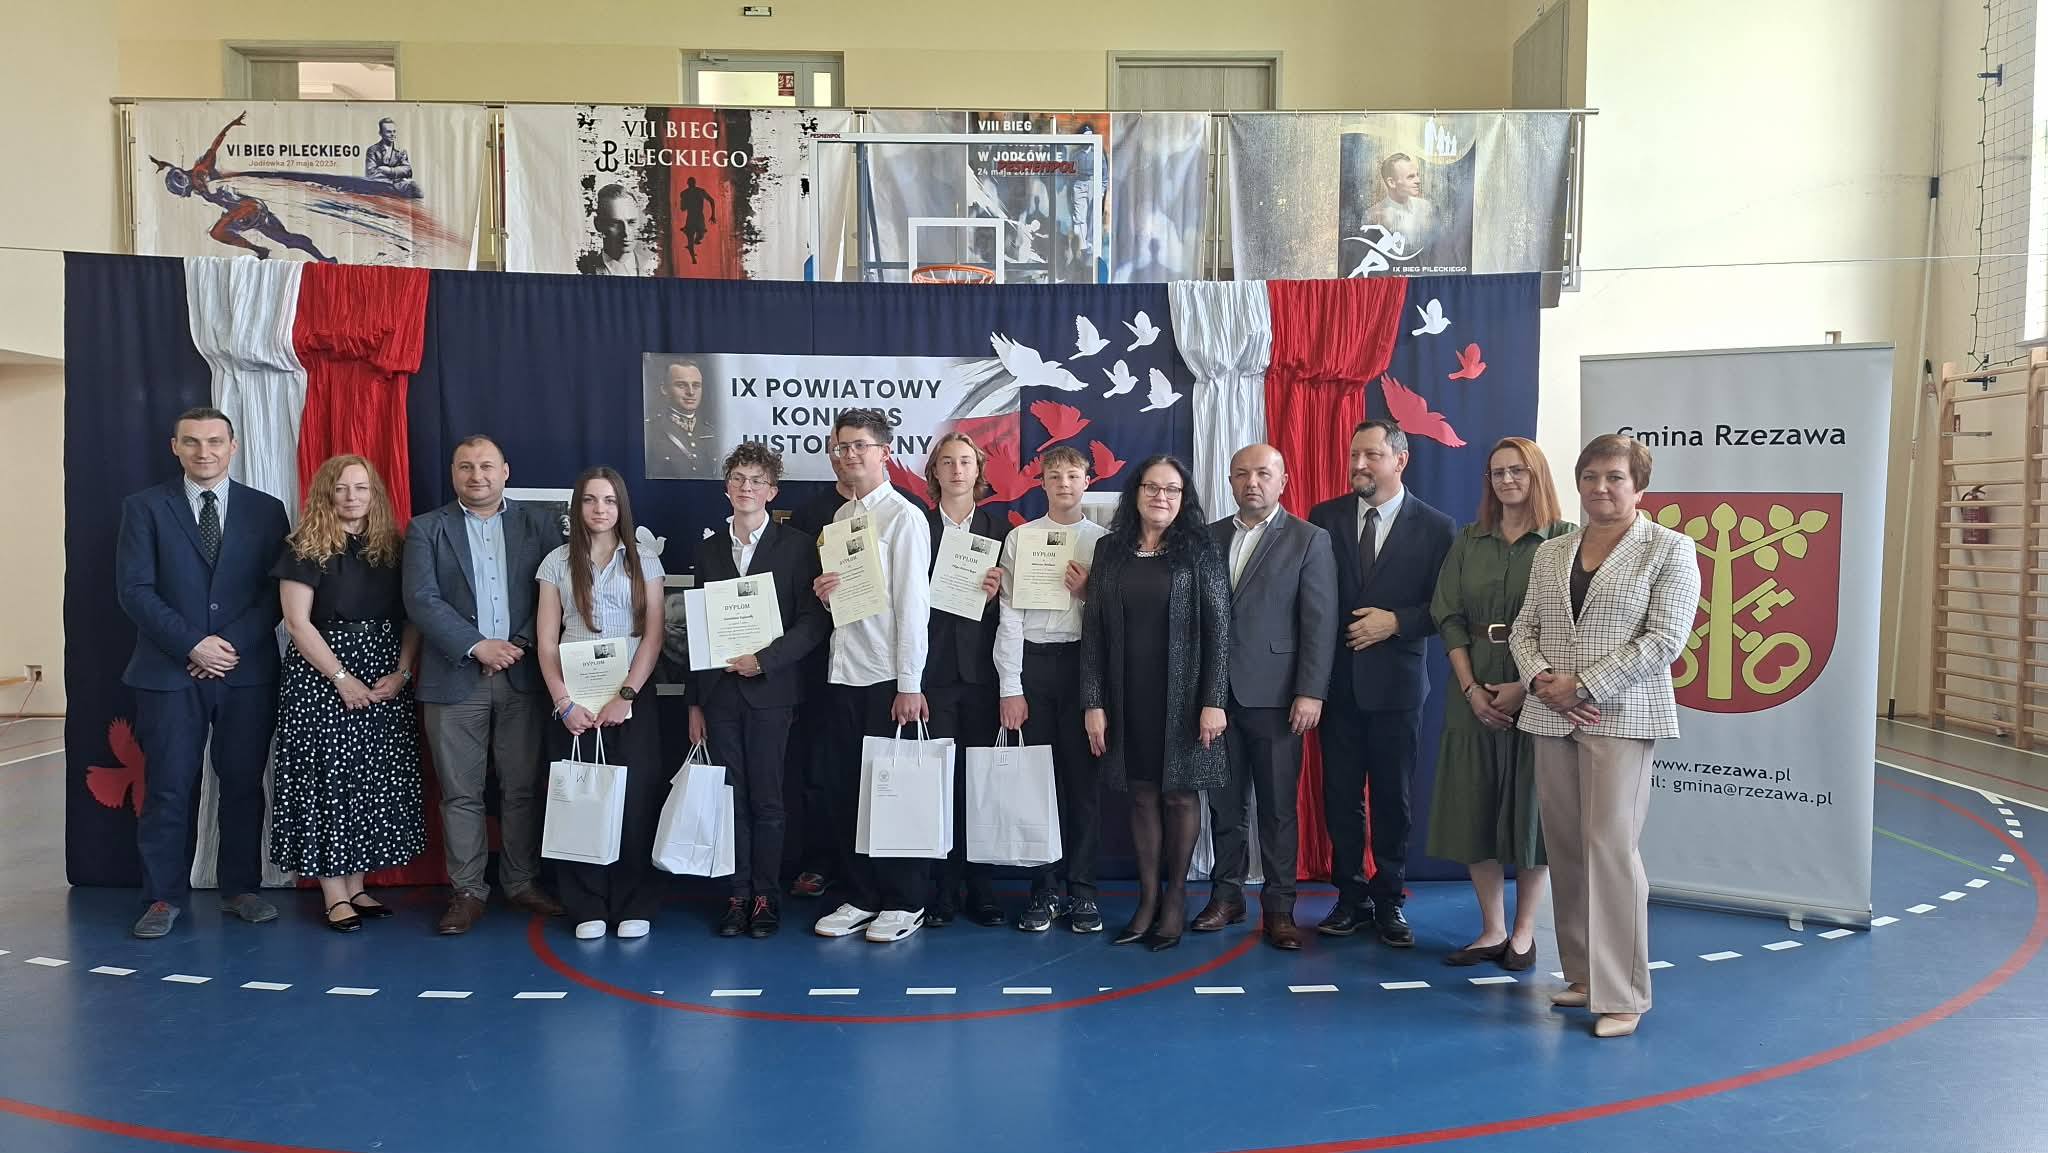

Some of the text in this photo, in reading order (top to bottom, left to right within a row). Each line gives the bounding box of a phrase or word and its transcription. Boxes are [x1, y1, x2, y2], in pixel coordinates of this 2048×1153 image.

[622, 120, 719, 138] VII BIEG
[978, 120, 1032, 132] VIII BIEG
[226, 144, 360, 157] VI BIEG PILECKIEGO
[978, 152, 990, 162] W
[296, 160, 313, 168] maja
[732, 378, 942, 399] IX POWIATOWY
[772, 406, 902, 427] KONKS
[1715, 424, 1846, 446] Rzezawa
[1673, 779, 1832, 806] gmina@rzezawa.pl
